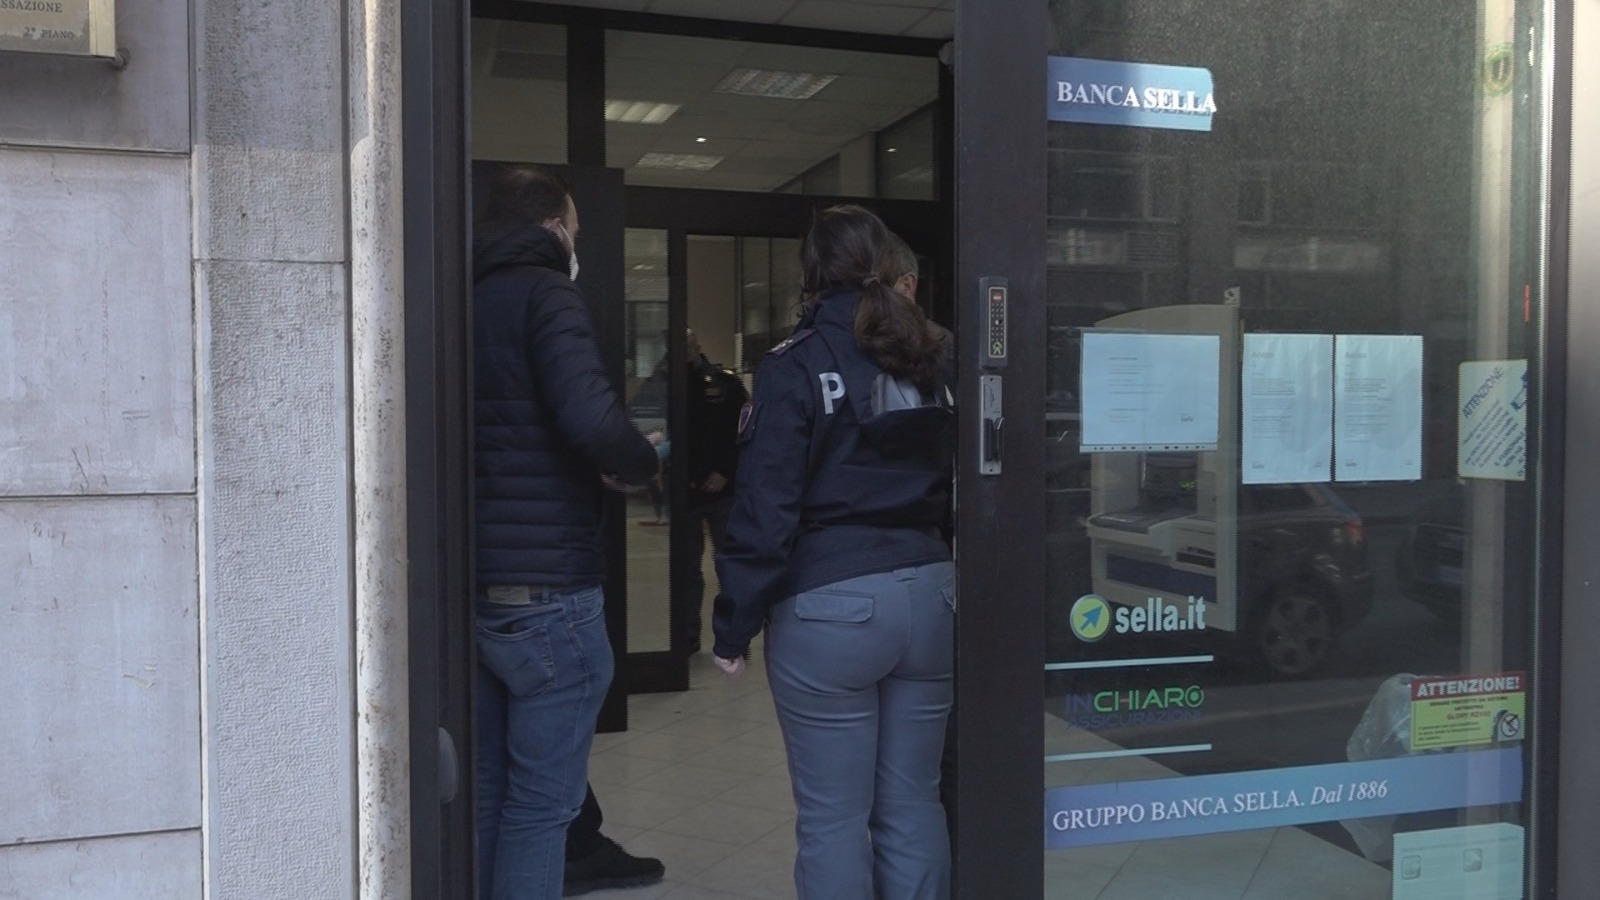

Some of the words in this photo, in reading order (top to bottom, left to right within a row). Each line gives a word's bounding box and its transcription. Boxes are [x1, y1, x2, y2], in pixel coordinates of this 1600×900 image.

[0, 0, 62, 13] SSAZIONE
[41, 30, 75, 40] PIANO
[1056, 81, 1141, 108] BANCA
[1143, 87, 1217, 112] SELLA
[1114, 595, 1206, 634] sella.it
[1417, 676, 1520, 697] ATTENZIONE!
[1052, 803, 1145, 831] GRUPPO
[1151, 797, 1229, 822] BANCA
[1233, 789, 1305, 814] SELLA.
[1310, 783, 1344, 805] Dal
[1347, 779, 1388, 801] 1886
